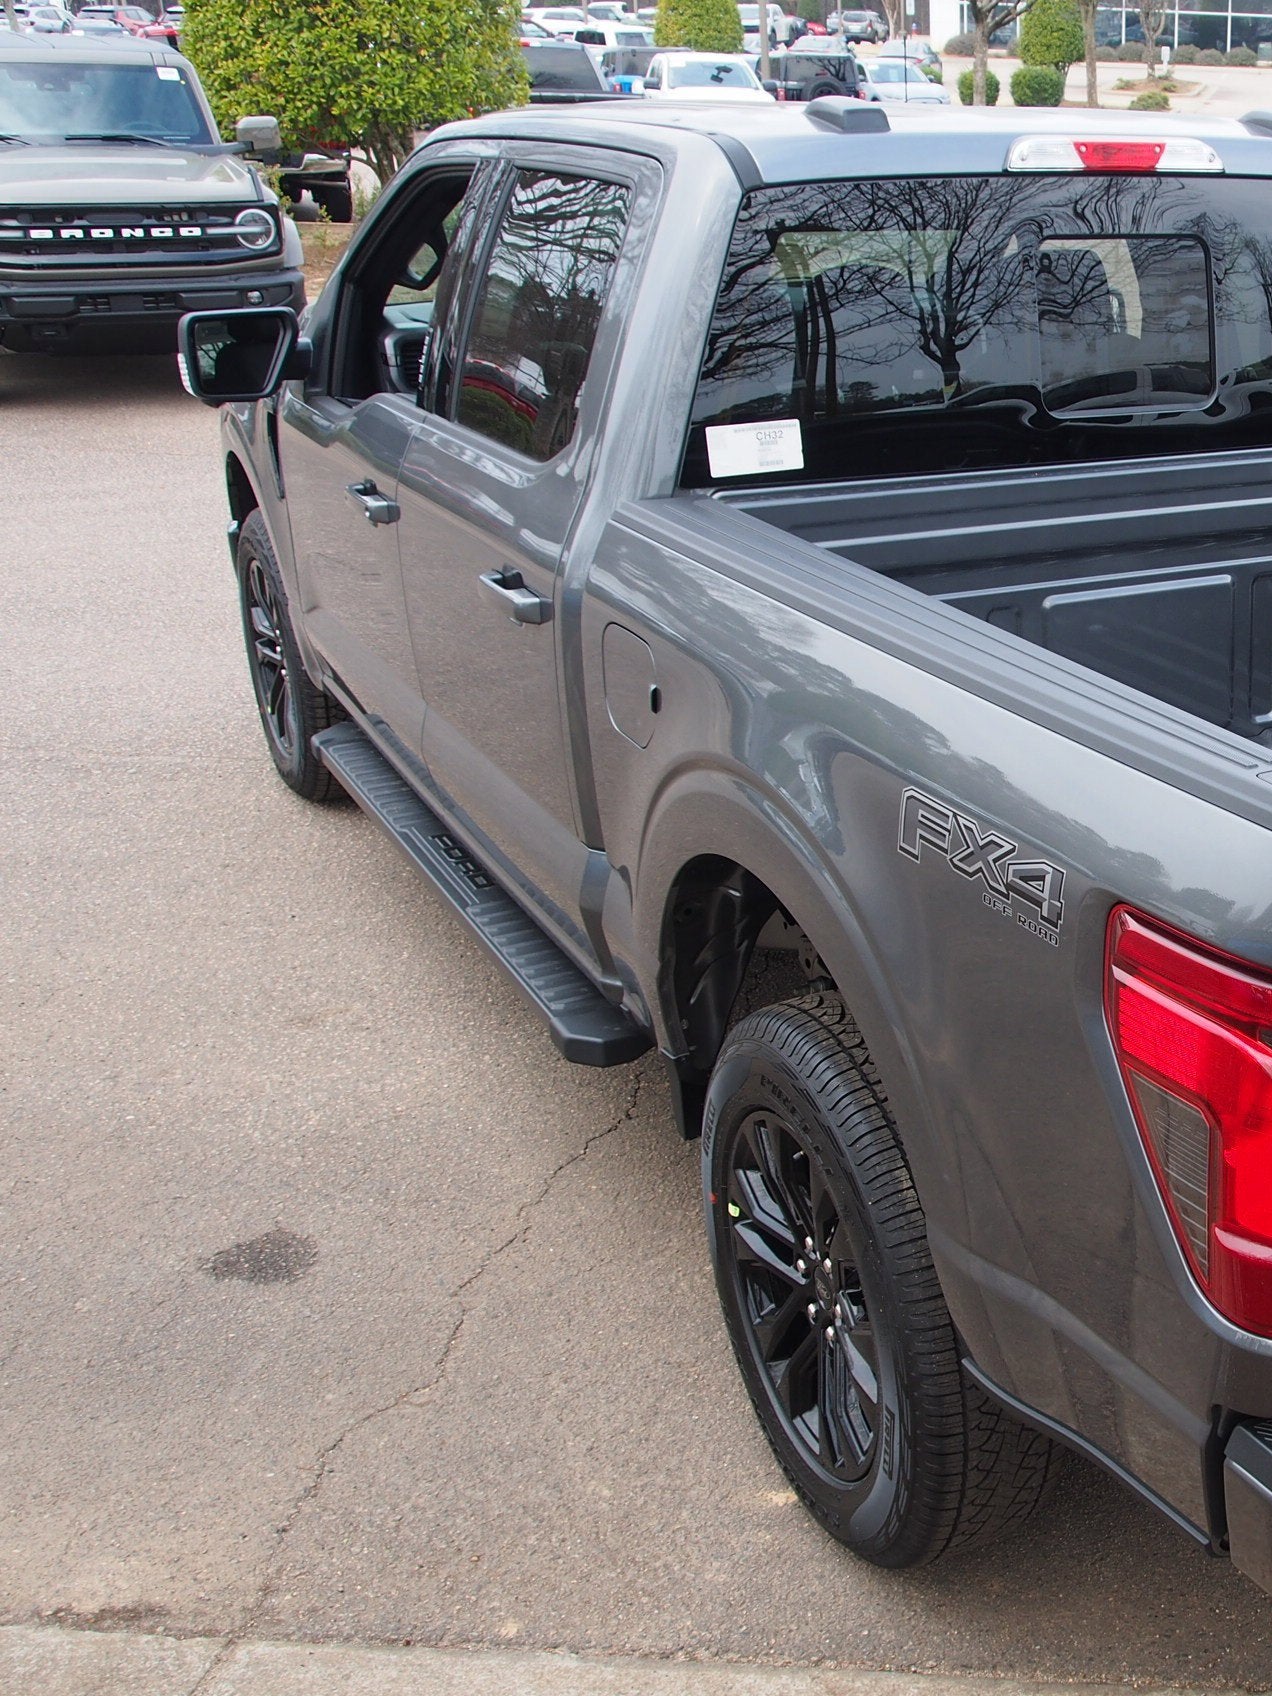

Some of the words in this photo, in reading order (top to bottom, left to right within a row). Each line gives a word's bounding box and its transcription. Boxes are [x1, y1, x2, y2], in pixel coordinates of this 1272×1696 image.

[29, 227, 202, 239] BRONCO
[755, 430, 784, 441] CH32
[428, 834, 496, 890] FORD
[898, 786, 1066, 932] FX4
[983, 893, 1013, 917] OFF
[1017, 912, 1059, 947] ROAD
